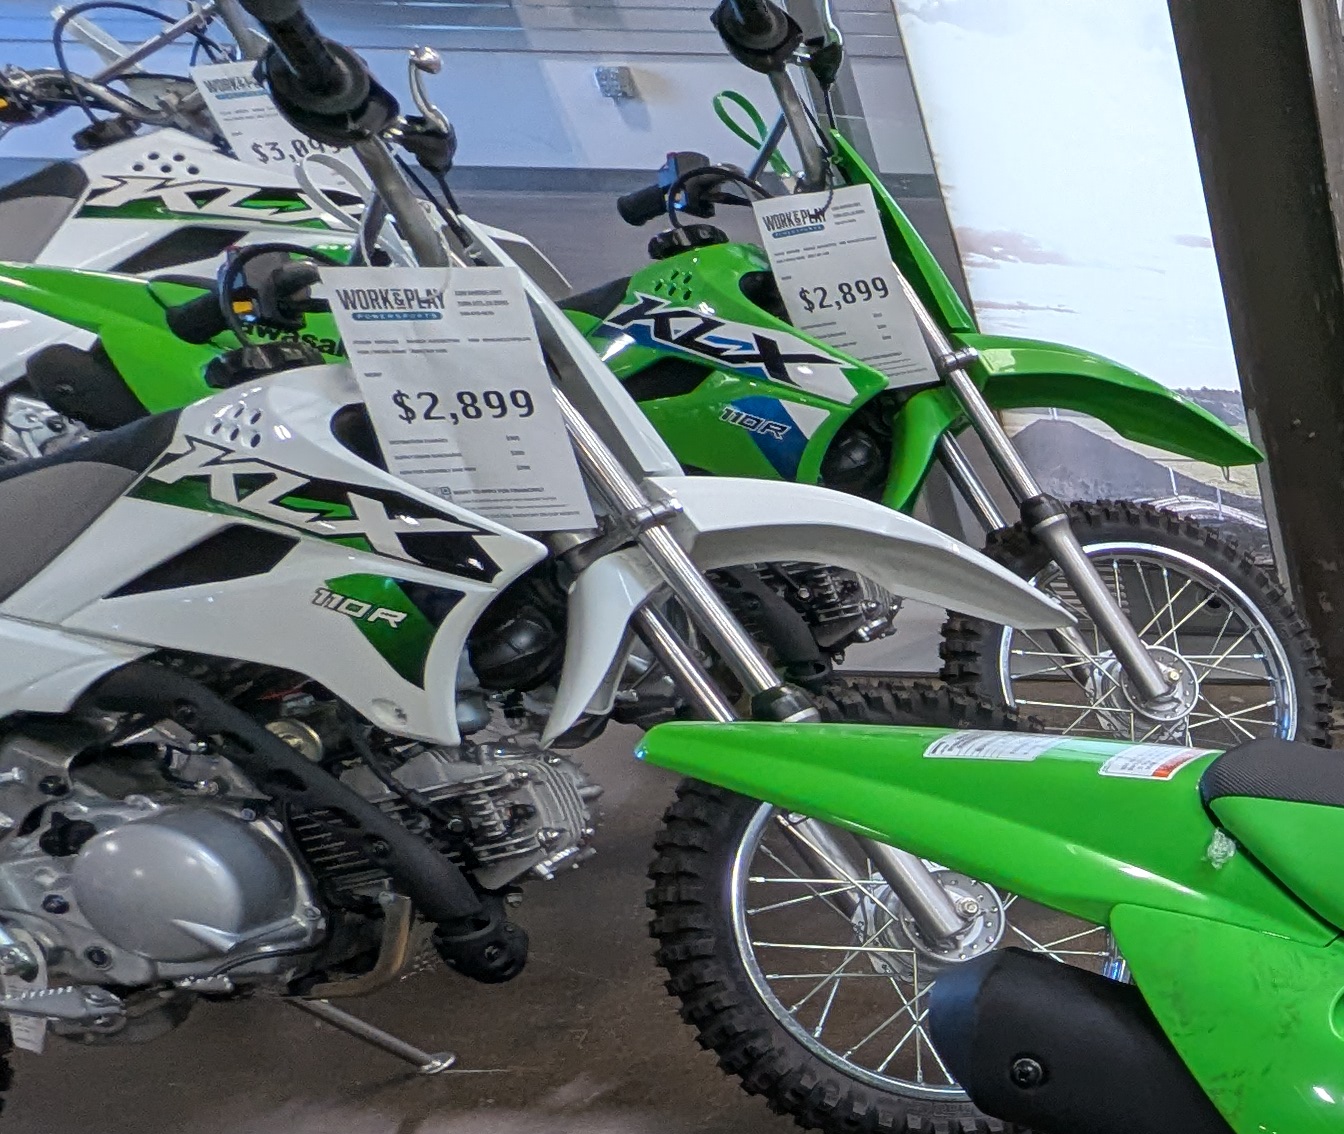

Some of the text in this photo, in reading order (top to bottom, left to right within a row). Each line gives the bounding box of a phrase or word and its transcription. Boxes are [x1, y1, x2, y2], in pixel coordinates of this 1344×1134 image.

[335, 288, 446, 310] WORK&PLAY
[799, 276, 889, 313] $2,899
[603, 293, 852, 389] KLX
[392, 389, 534, 425] $2,899
[719, 405, 792, 440] 110R
[147, 435, 501, 566] KLX
[311, 587, 408, 628] 110R
